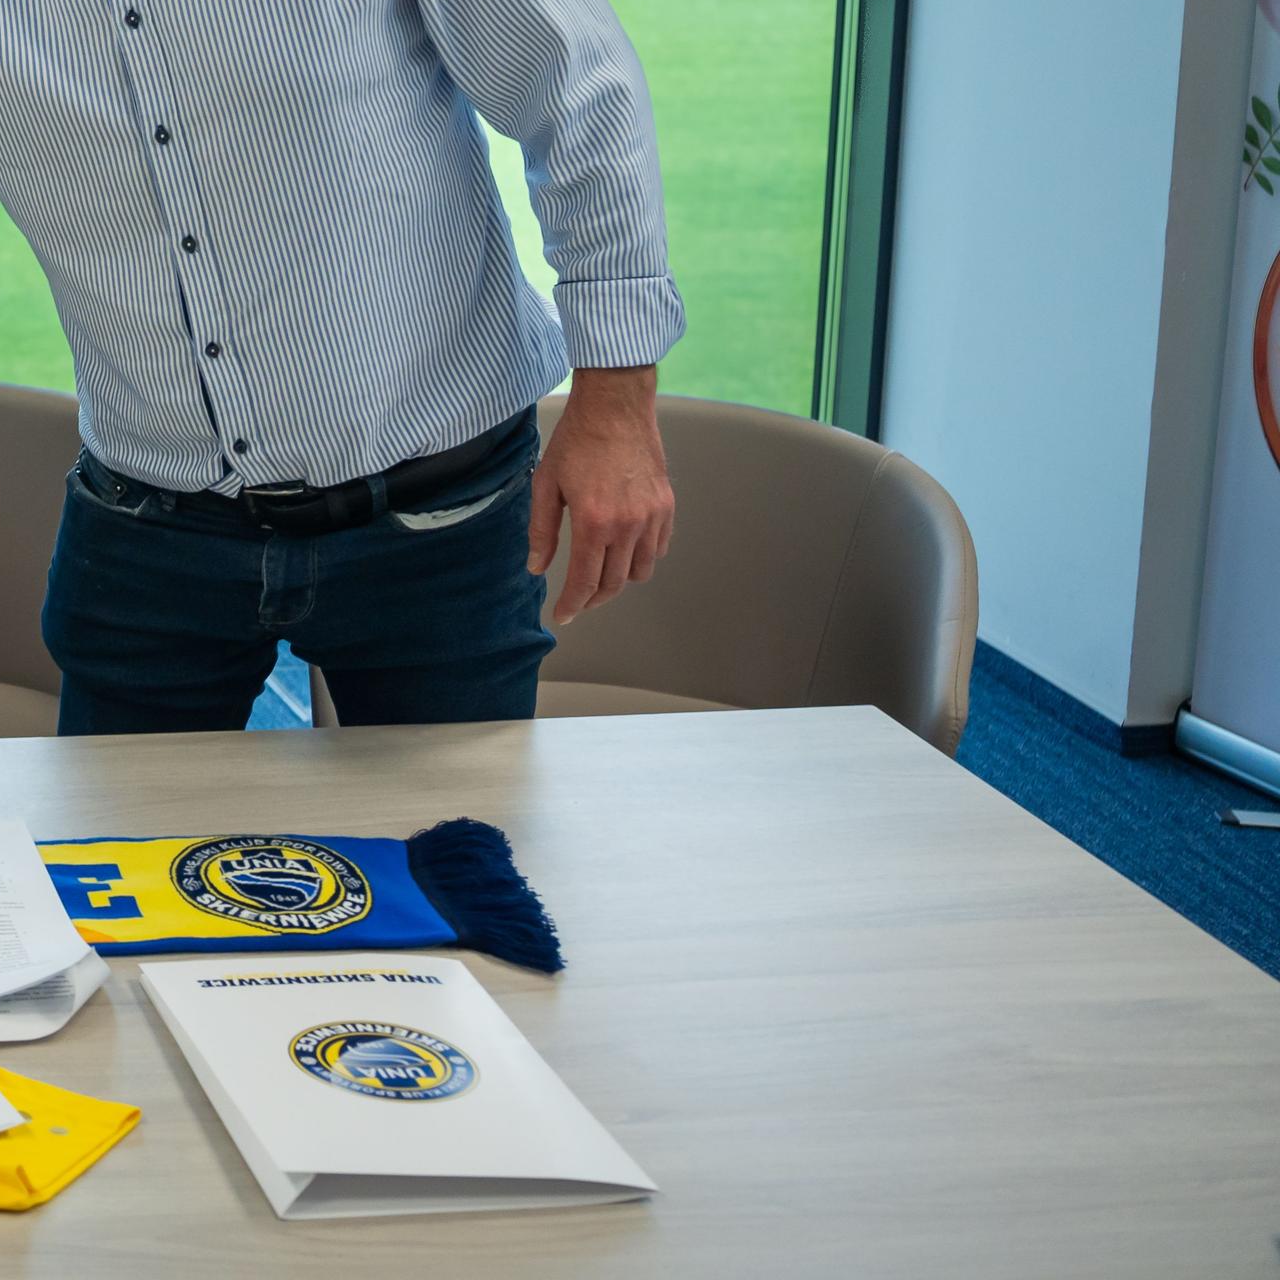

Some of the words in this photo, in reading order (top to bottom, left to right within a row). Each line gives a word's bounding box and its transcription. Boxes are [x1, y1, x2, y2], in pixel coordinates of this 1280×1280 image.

[221, 839, 267, 851] KLUB
[230, 858, 309, 872] UNIA
[196, 892, 366, 930] SKIERNIEWICE
[197, 973, 376, 988] SKIERNIEWICE
[380, 974, 443, 985] UNIA
[296, 1023, 452, 1053] SKIERNIEWICE
[357, 1066, 427, 1079] UNIA
